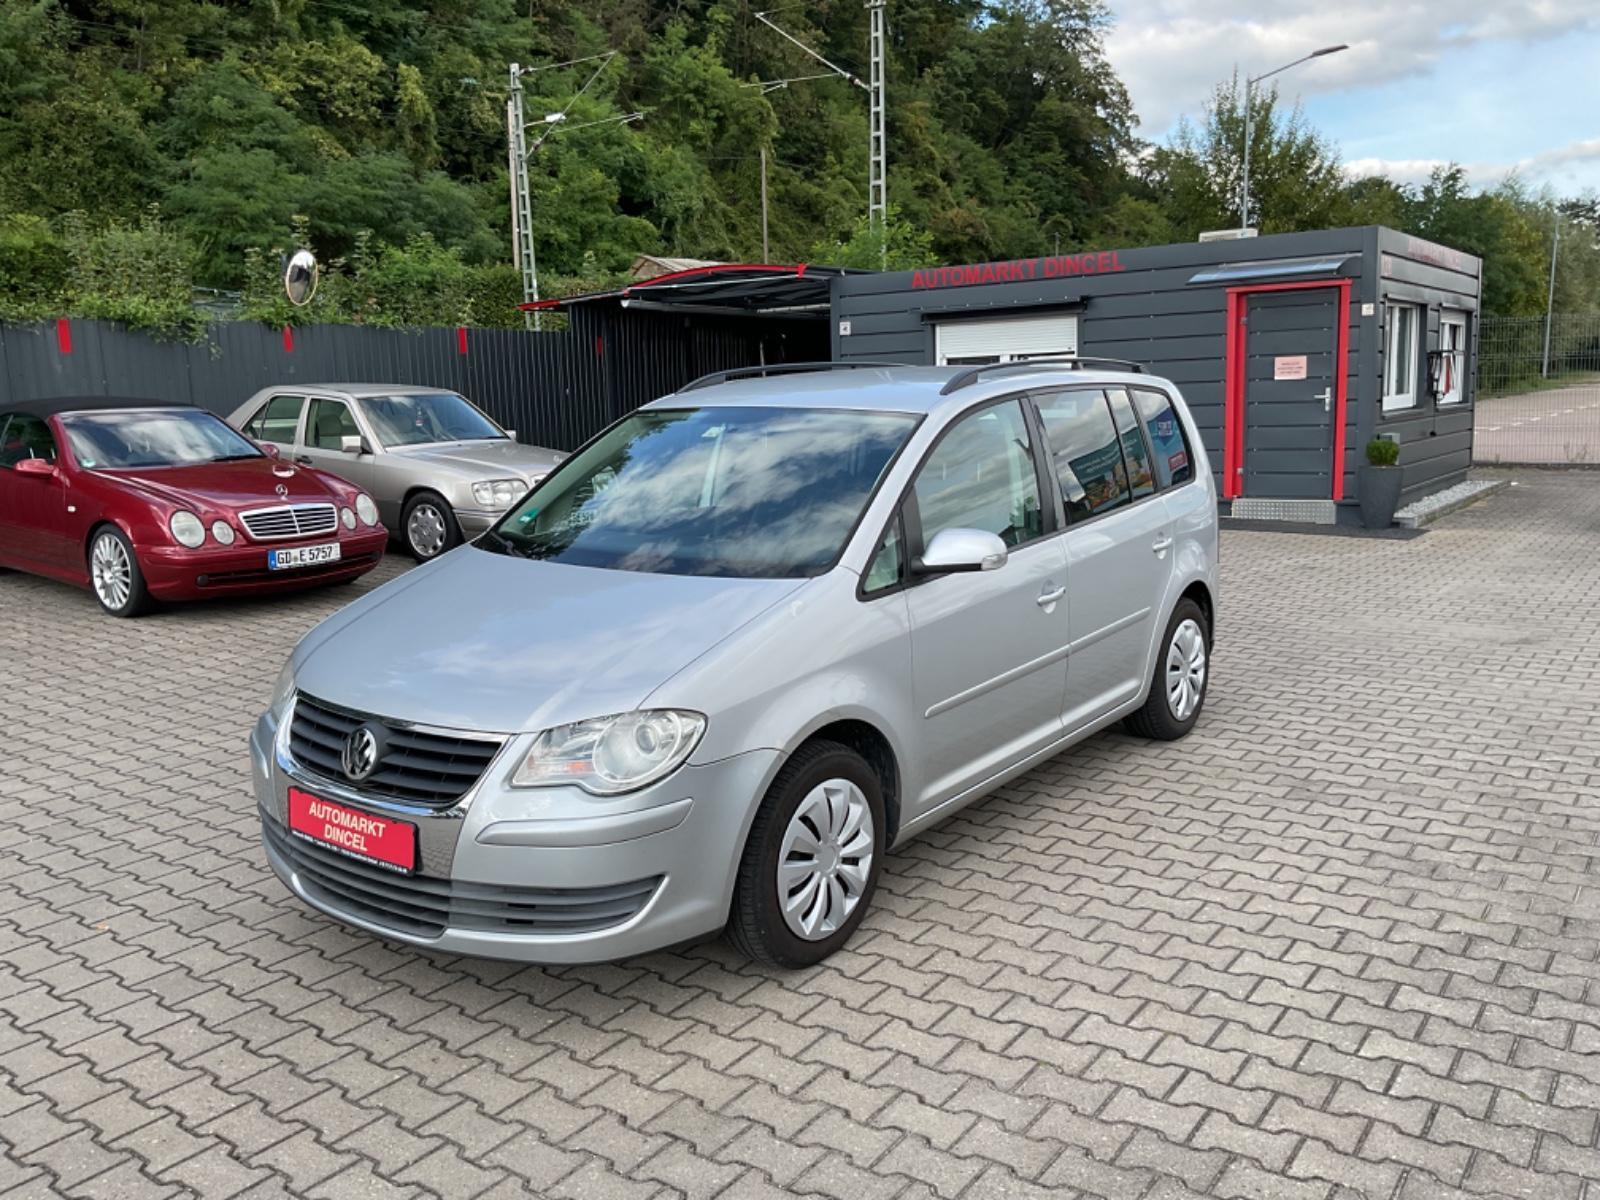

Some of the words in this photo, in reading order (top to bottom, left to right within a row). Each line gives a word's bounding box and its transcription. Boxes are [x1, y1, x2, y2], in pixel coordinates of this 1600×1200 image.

[912, 259, 1039, 288] AUTOMARKT
[1044, 251, 1125, 278] DINCEL
[277, 551, 291, 564] GD
[299, 549, 307, 562] E
[308, 545, 333, 561] 5757
[308, 801, 386, 838] AUTOMARKT
[324, 823, 368, 851] DINCEL
